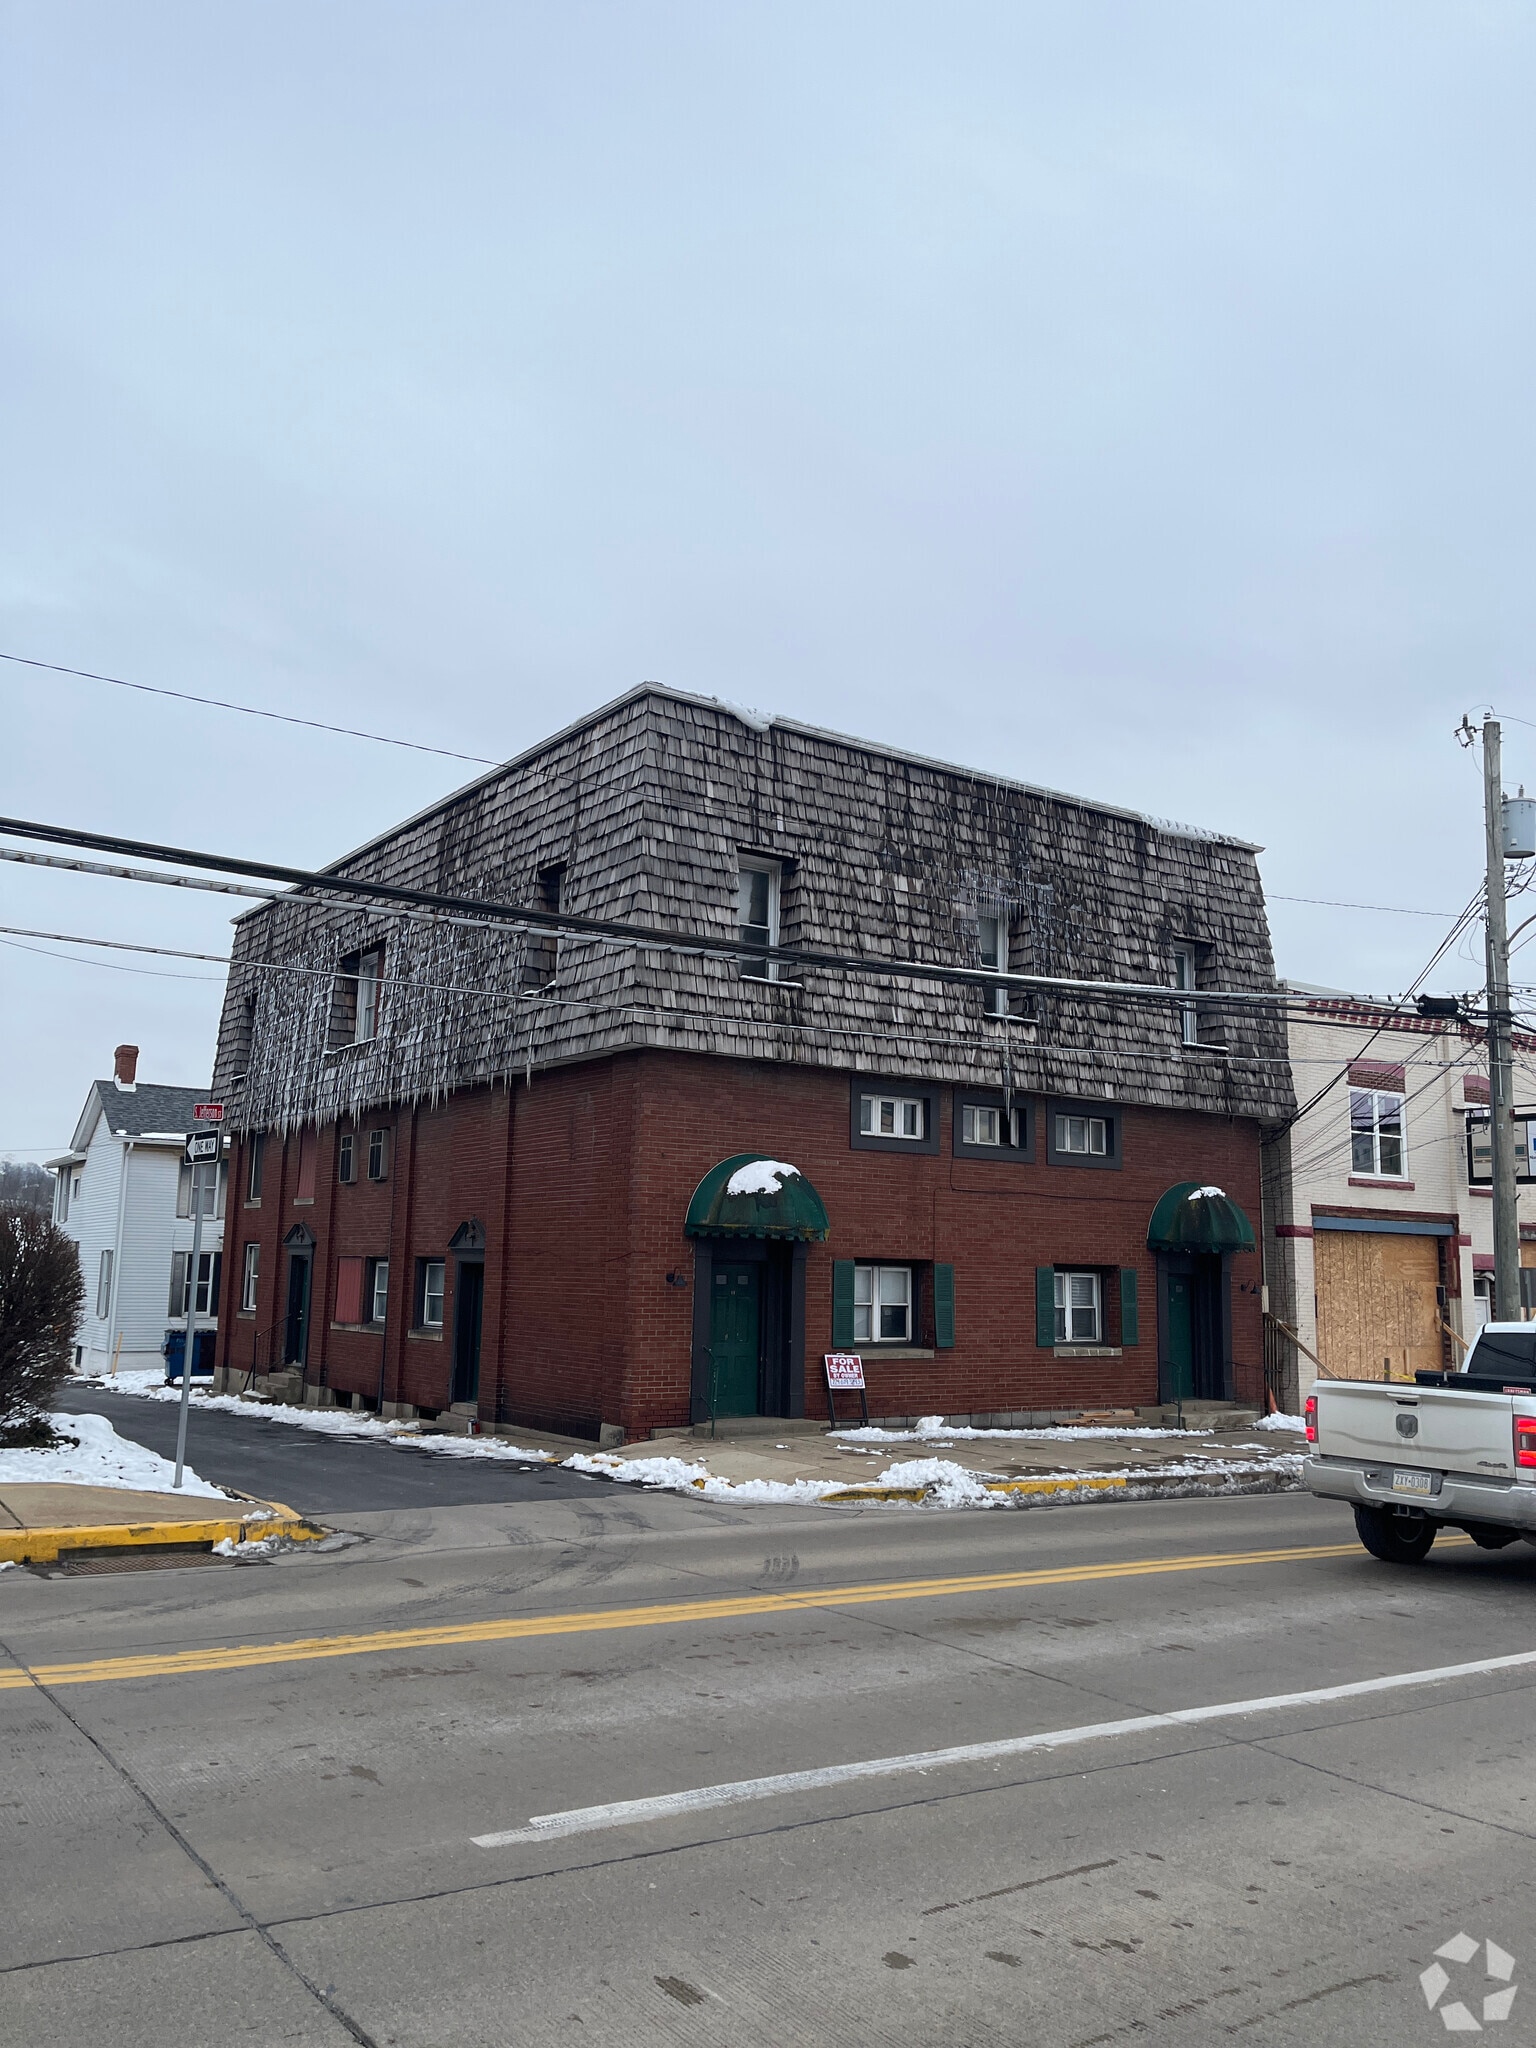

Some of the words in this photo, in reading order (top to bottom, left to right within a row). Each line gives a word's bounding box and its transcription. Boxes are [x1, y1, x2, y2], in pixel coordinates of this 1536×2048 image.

[199, 1105, 217, 1118] Jefferson
[194, 1141, 204, 1154] ONE
[205, 1139, 215, 1153] WAY
[829, 1365, 860, 1373] SALE
